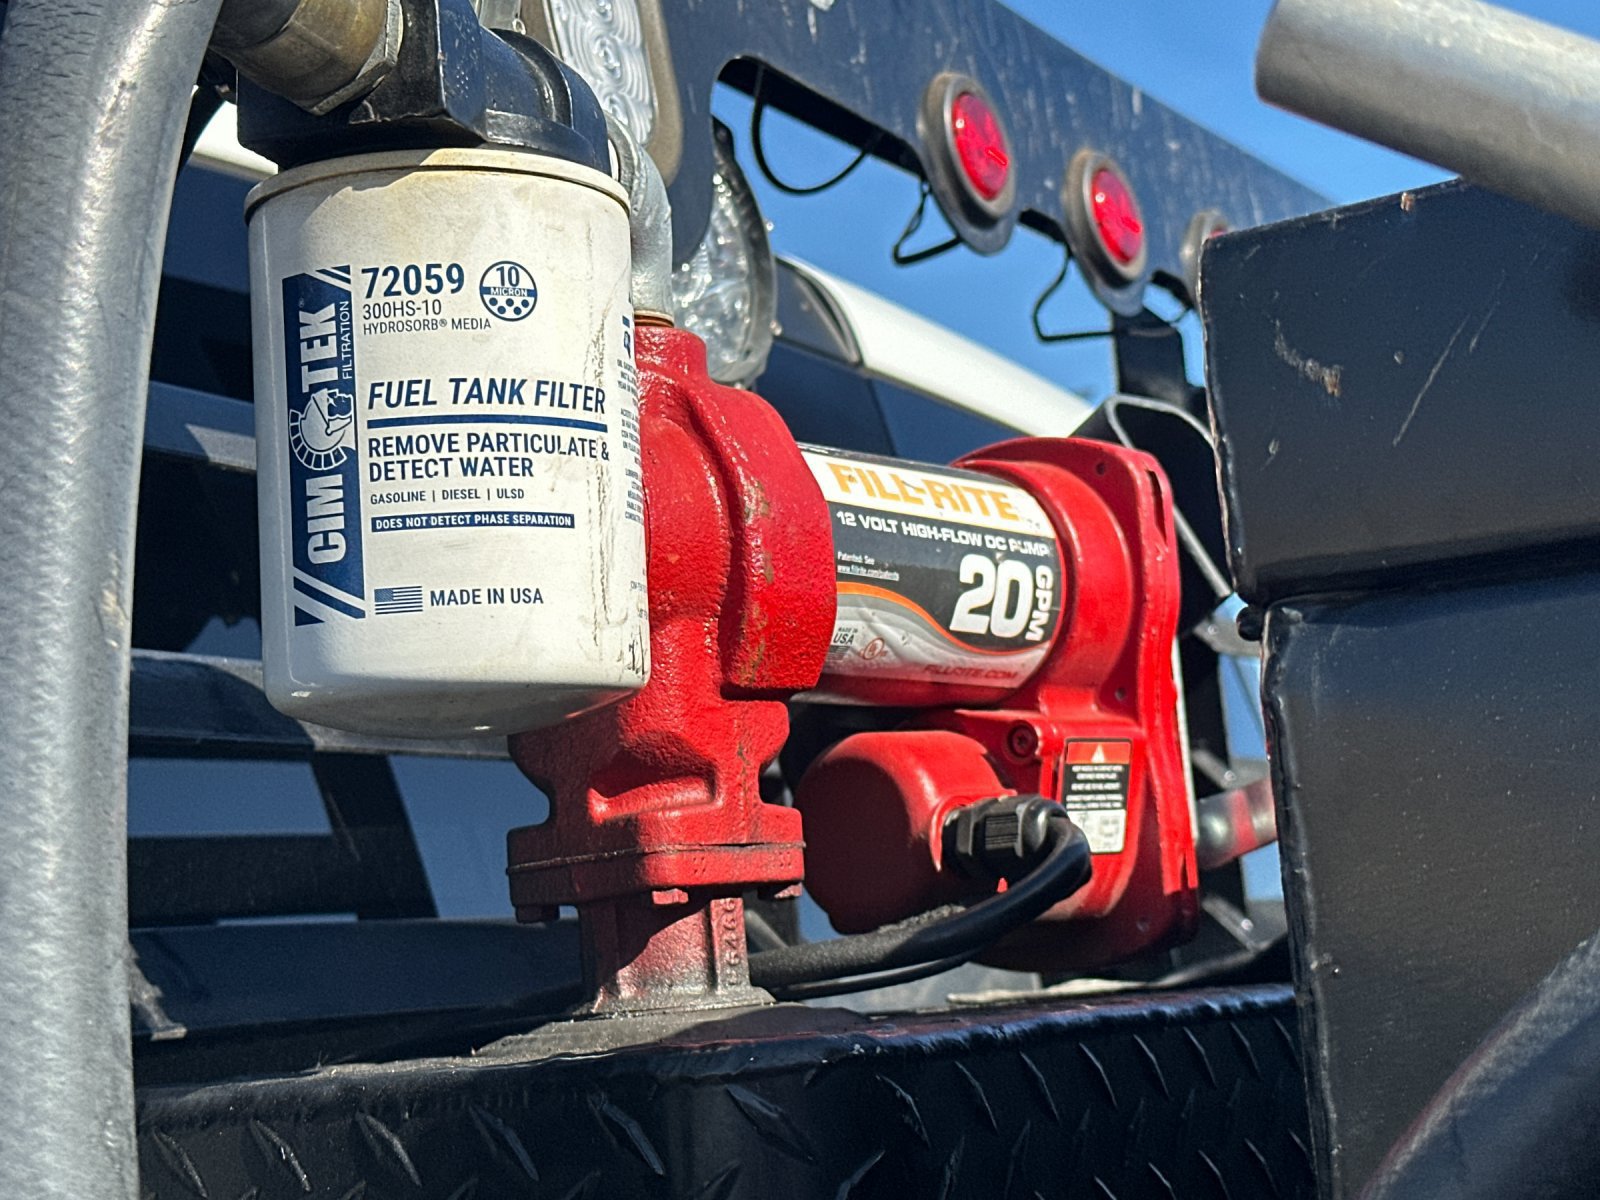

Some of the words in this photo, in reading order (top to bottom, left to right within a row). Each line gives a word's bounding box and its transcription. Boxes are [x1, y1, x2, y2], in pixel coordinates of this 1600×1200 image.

[361, 262, 465, 299] 72059
[496, 266, 520, 288] 10
[490, 286, 528, 297] MICRON
[362, 298, 442, 321] 300HS-10
[451, 317, 492, 331] MEDIA
[298, 302, 339, 394] TEK
[339, 300, 353, 380] FILTRATION
[367, 378, 437, 411] FUEL
[448, 377, 527, 407] TANK
[533, 378, 606, 414] FILTER
[368, 434, 459, 459] REMOVE
[466, 431, 598, 460] PARTICULATE
[600, 439, 610, 461] &
[368, 458, 449, 483] DETECT
[459, 457, 534, 478] WATER
[370, 489, 427, 505] GASOLINE
[441, 488, 481, 501] DIESEL
[496, 488, 525, 500] ULSD
[825, 462, 1021, 522] FILL-RITE
[306, 473, 348, 565] CIM
[375, 517, 404, 530] DOES
[405, 516, 429, 528] NOT
[430, 514, 472, 527] DETECT
[473, 513, 510, 525] PHASE
[511, 512, 572, 528] SEPARATION
[836, 510, 857, 528] 12
[857, 513, 899, 535] VOLT
[899, 520, 983, 548] HIGH-FLOW
[984, 534, 1007, 551] DC
[1008, 538, 1050, 558] PUMP
[430, 588, 483, 607] MADE
[486, 588, 504, 606] IN
[509, 587, 544, 605] USA
[949, 553, 1034, 639] 20
[1024, 564, 1054, 642] GPM
[832, 632, 855, 645] USA
